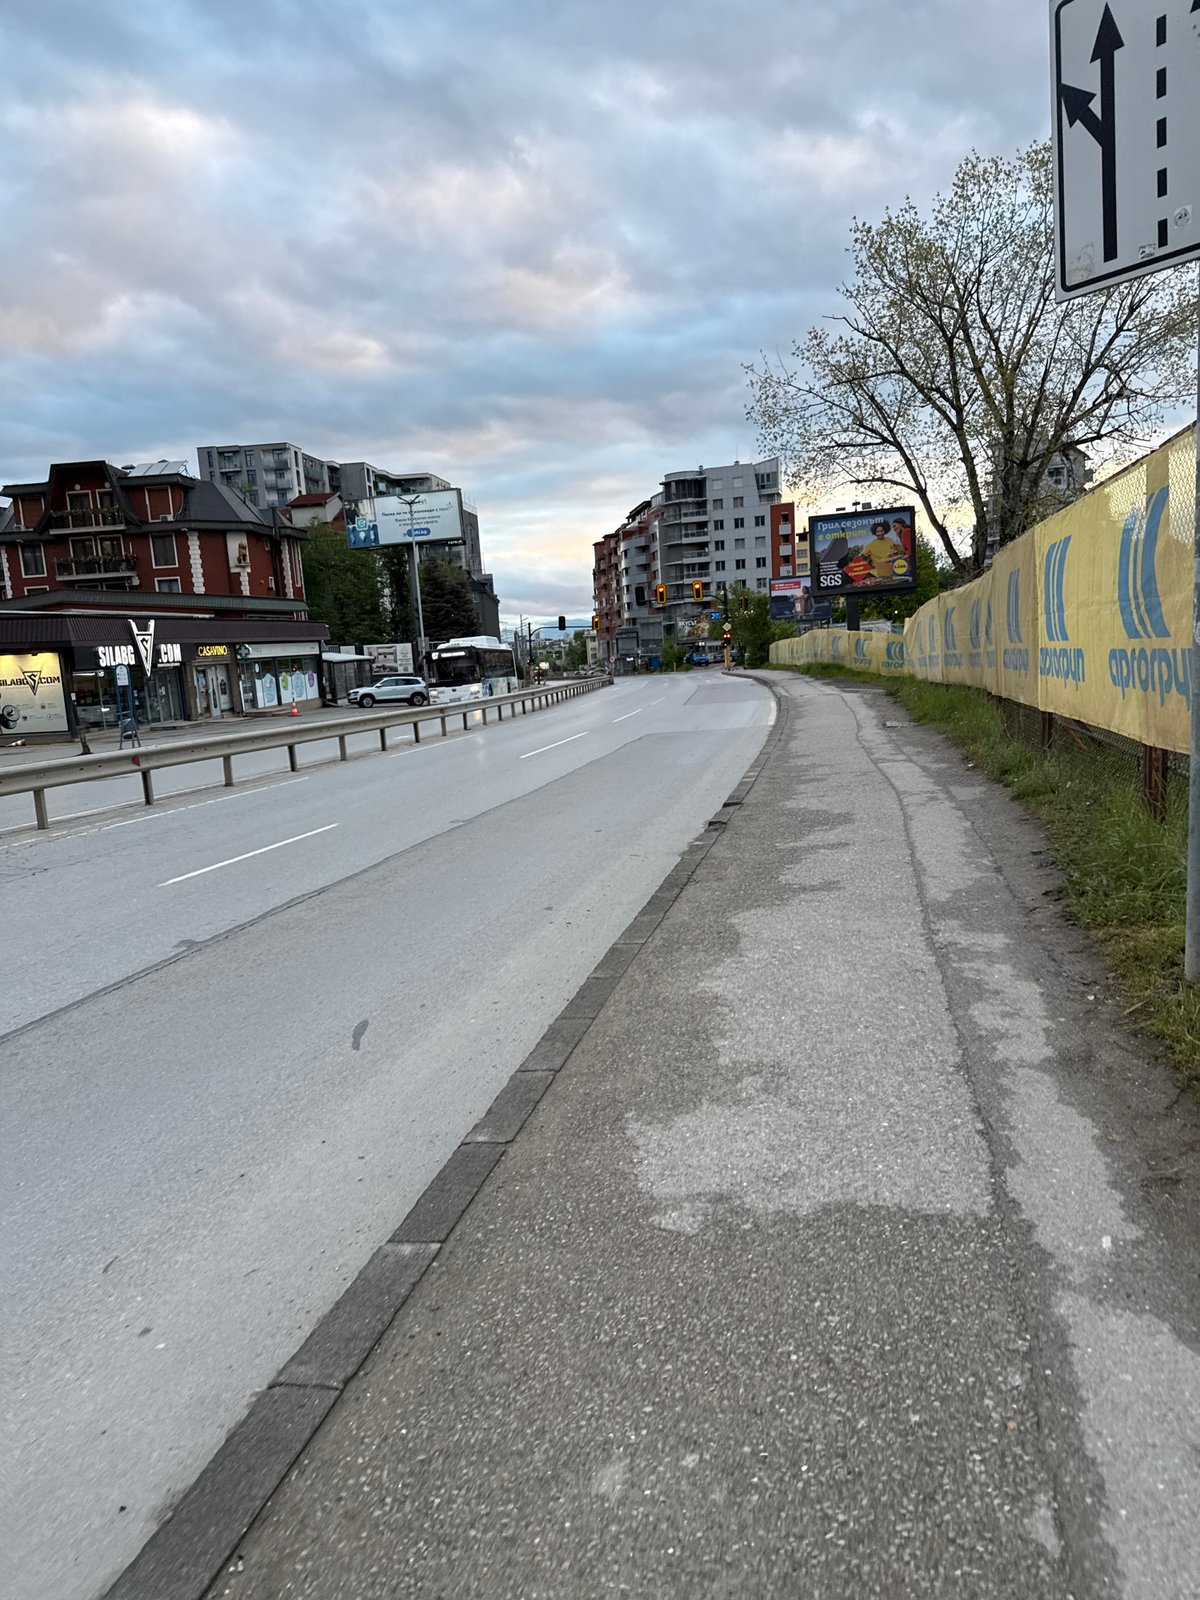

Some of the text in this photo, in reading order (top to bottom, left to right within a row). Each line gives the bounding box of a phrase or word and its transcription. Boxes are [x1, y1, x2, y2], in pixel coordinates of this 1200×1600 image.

[818, 517, 884, 532] Грил сезонът
[826, 529, 867, 541] открит
[820, 574, 842, 587] SGS
[98, 643, 182, 667] SILABG .COM
[1108, 647, 1192, 711] аргогру
